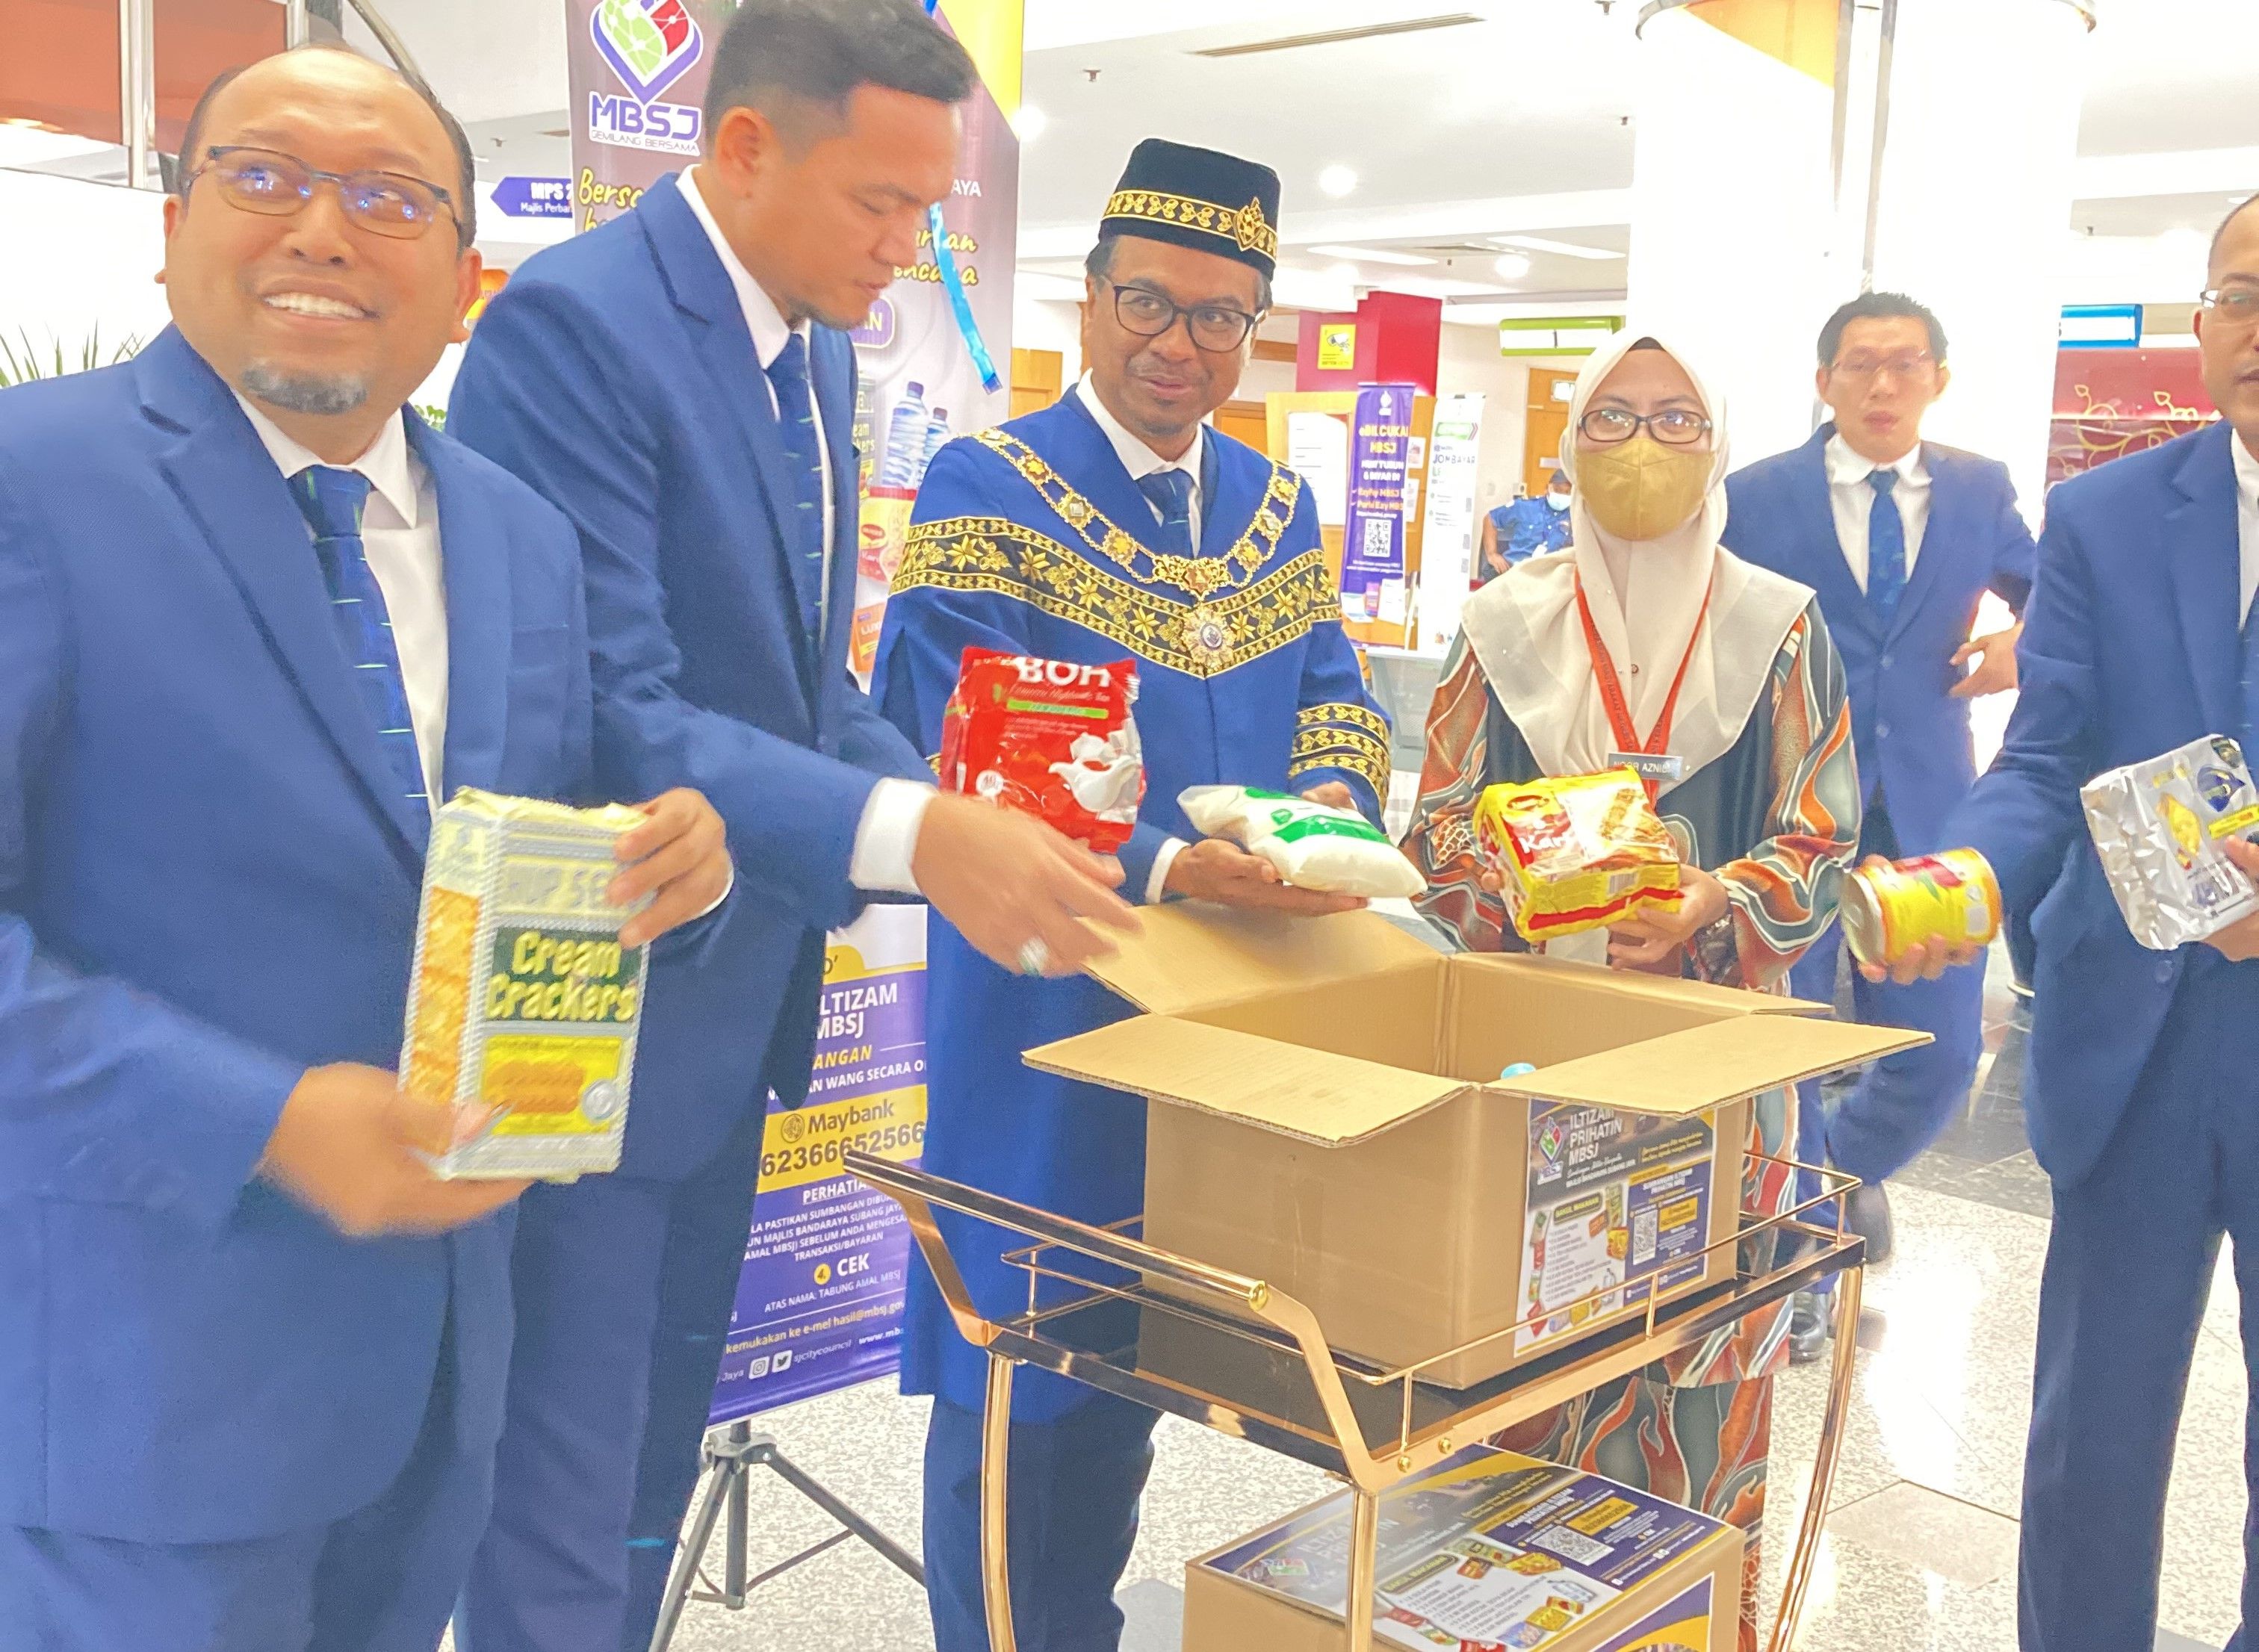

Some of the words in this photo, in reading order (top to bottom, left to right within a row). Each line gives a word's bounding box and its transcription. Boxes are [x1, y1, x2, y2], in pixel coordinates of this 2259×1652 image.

[592, 94, 699, 140] MBSJ
[591, 129, 641, 146] GEMILANG
[645, 137, 698, 153] BERSAMA
[512, 931, 622, 978] Cream
[486, 972, 637, 1022] Crackers
[825, 1070, 864, 1090] WANG
[867, 1063, 911, 1081] SECARA
[808, 1099, 895, 1134] Maybank
[1569, 1119, 1623, 1149] PRIHATIN
[1569, 1142, 1599, 1166] MBSJ
[763, 1229, 793, 1243] MAJLIS
[796, 1215, 849, 1235] BANDARAYA
[850, 1205, 884, 1223] SUBANG
[765, 1212, 808, 1230] PASTIKAN
[809, 1199, 865, 1220] SUMBANGAN
[743, 1247, 771, 1261] AMAL
[799, 1230, 839, 1248] SEBELUM
[840, 1222, 864, 1238] ANDA
[866, 1214, 908, 1231] MENGESA
[794, 1232, 884, 1261] TRANSAKSI/BAYARAN
[837, 1252, 870, 1276] CEK
[764, 1299, 787, 1312] ATAS
[819, 1280, 855, 1298] TABUNG
[855, 1276, 878, 1289] AMAL
[881, 1269, 901, 1282] MBSJ
[725, 1331, 787, 1354] kemukakan
[788, 1326, 801, 1338] ke
[803, 1319, 831, 1335] e-mel
